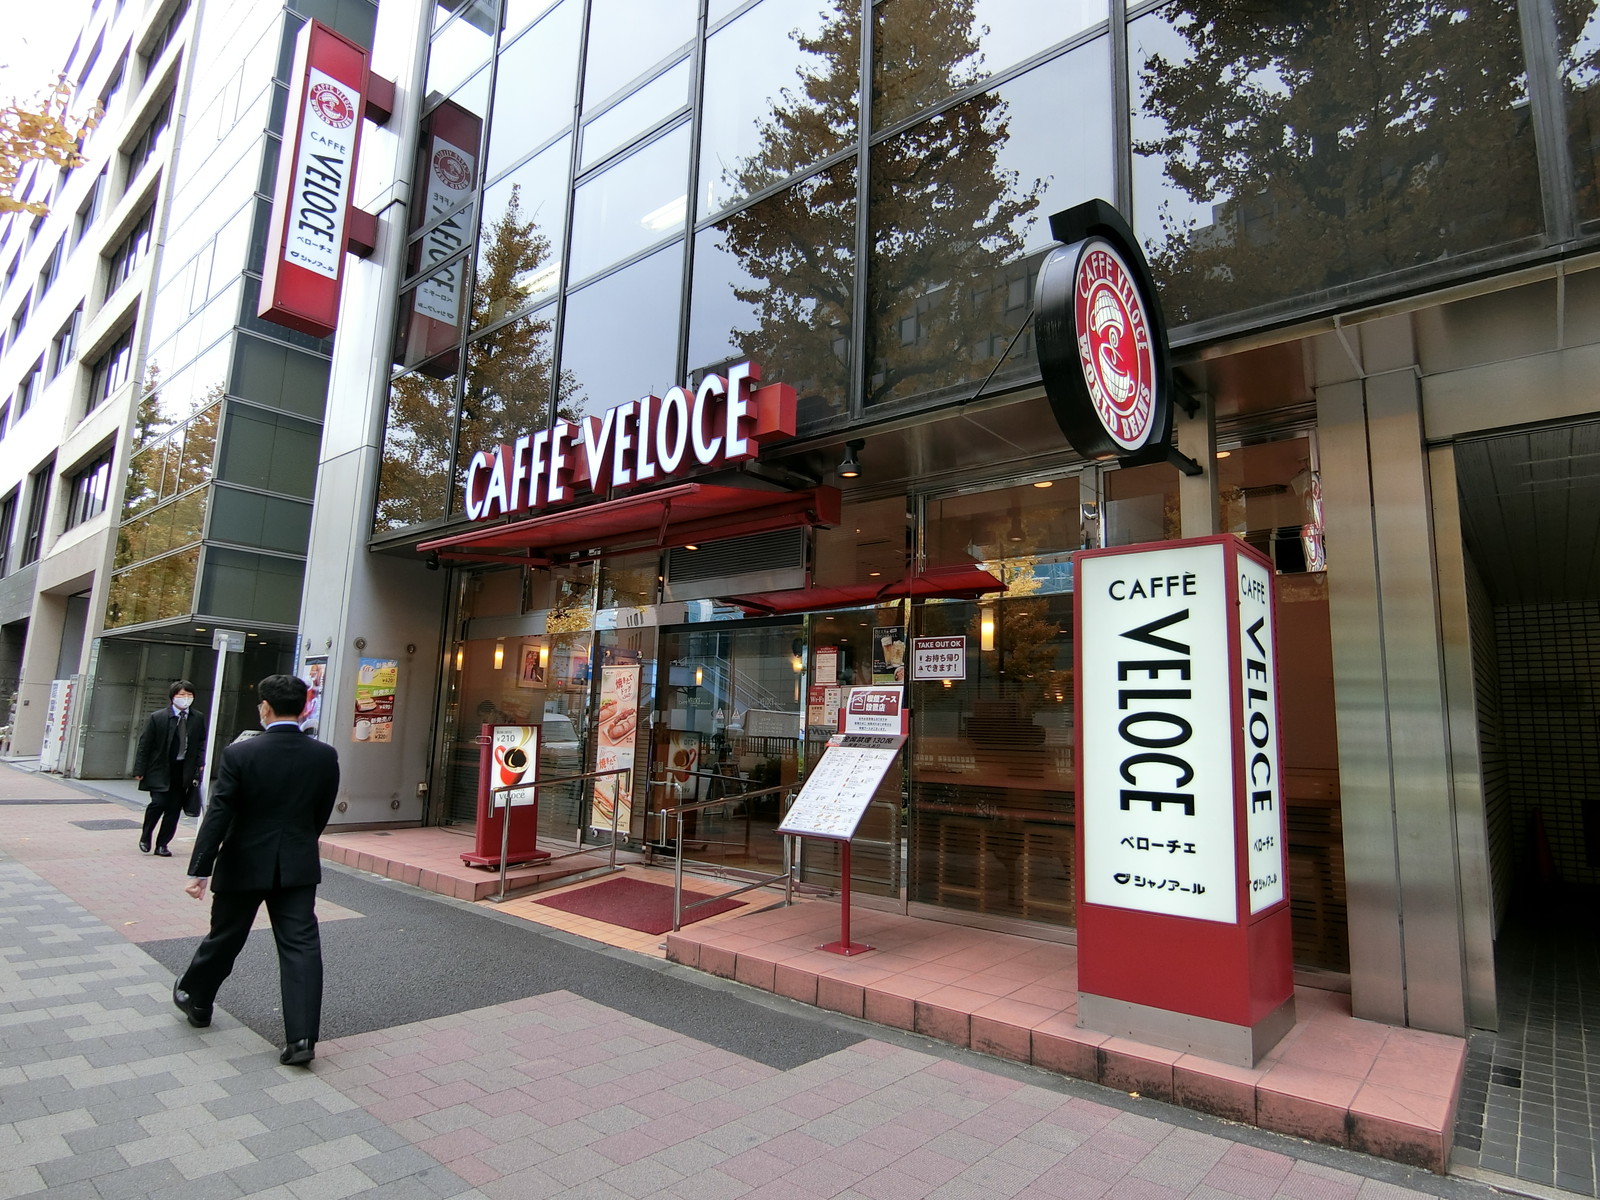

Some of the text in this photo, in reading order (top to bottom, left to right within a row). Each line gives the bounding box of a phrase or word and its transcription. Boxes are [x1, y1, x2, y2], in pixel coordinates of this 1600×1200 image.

[299, 153, 344, 243] VELOCE
[297, 236, 333, 254] ベローチェ
[301, 254, 334, 272] シャノアール
[1117, 268, 1149, 351] VELOCE
[1078, 332, 1151, 439] WORLD BEANS
[582, 360, 752, 494] VELOCE
[1108, 571, 1197, 601] CAFFÈ
[1240, 573, 1266, 605] CAFFÈ
[925, 653, 960, 663] お持ち帰り
[1117, 607, 1196, 817] VELOCE
[1245, 615, 1273, 815] VELOCE
[1120, 835, 1197, 855] ベローチェ
[1253, 834, 1274, 852] ベローチェ
[1134, 873, 1206, 896] シャノアール
